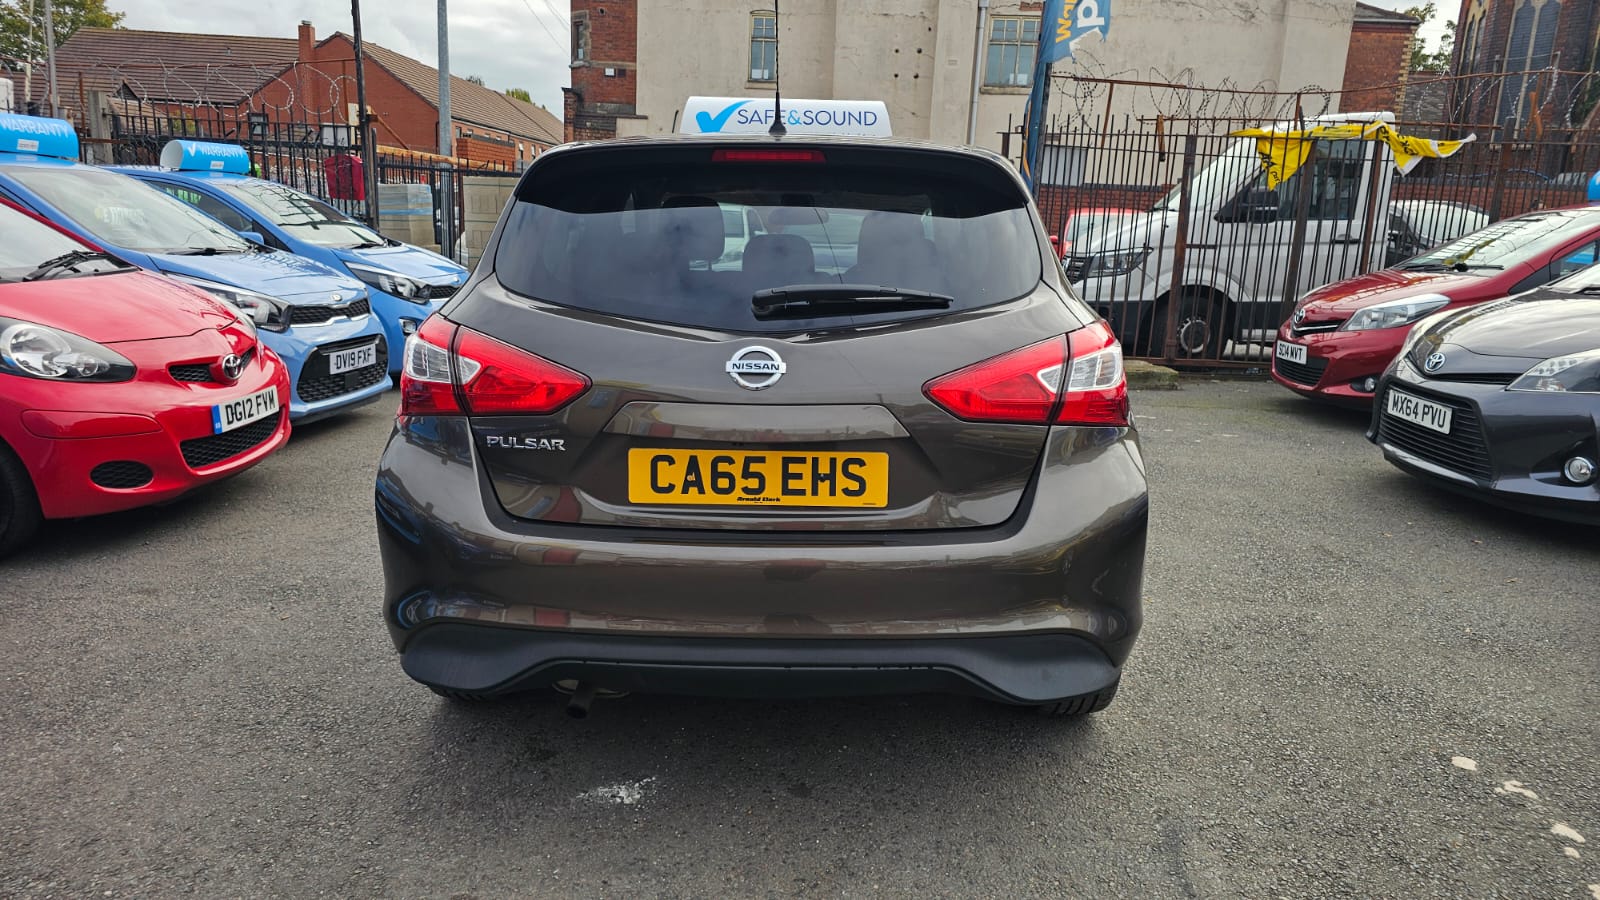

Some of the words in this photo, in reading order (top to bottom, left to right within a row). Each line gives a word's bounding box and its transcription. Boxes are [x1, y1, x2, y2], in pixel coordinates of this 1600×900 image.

[0, 118, 68, 138] WARRANTY
[200, 143, 244, 159] WARRANTY
[335, 351, 356, 370] DV19
[357, 347, 373, 366] FXF
[732, 362, 780, 371] NISSAN
[225, 398, 254, 426] DG12
[255, 389, 276, 416] FVM
[1391, 393, 1419, 420] MX64
[1421, 403, 1447, 429] PVU
[486, 435, 566, 451] PULSAR
[650, 454, 767, 495] CA65
[781, 456, 867, 497] EHS
